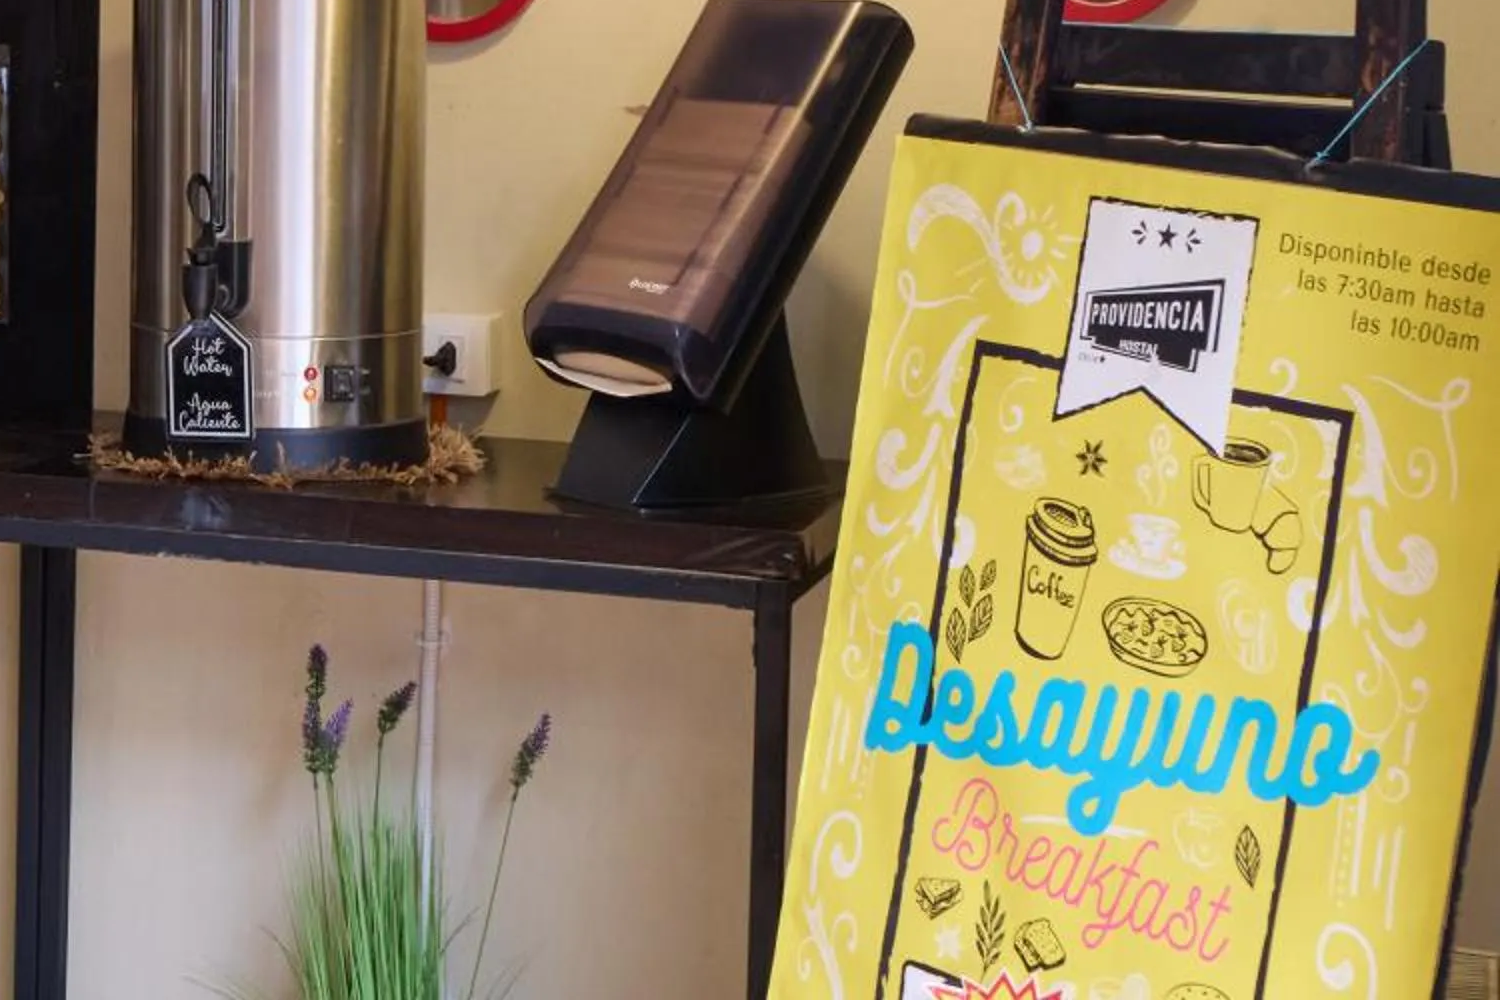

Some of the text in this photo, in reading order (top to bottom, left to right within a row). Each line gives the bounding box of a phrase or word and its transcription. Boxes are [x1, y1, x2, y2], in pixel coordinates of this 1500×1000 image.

[1278, 232, 1492, 286] Disponinble desde
[1297, 269, 1486, 319] las 7:30am hasta
[1090, 299, 1205, 333] PROVIDENCIA
[1350, 309, 1481, 351] las 10:00am
[183, 355, 233, 376] Water
[191, 337, 226, 359] Hot
[179, 410, 241, 432] Caliente
[187, 392, 233, 416] Agua
[864, 618, 1381, 837] Desayuno
[931, 777, 1238, 963] Breakfast
